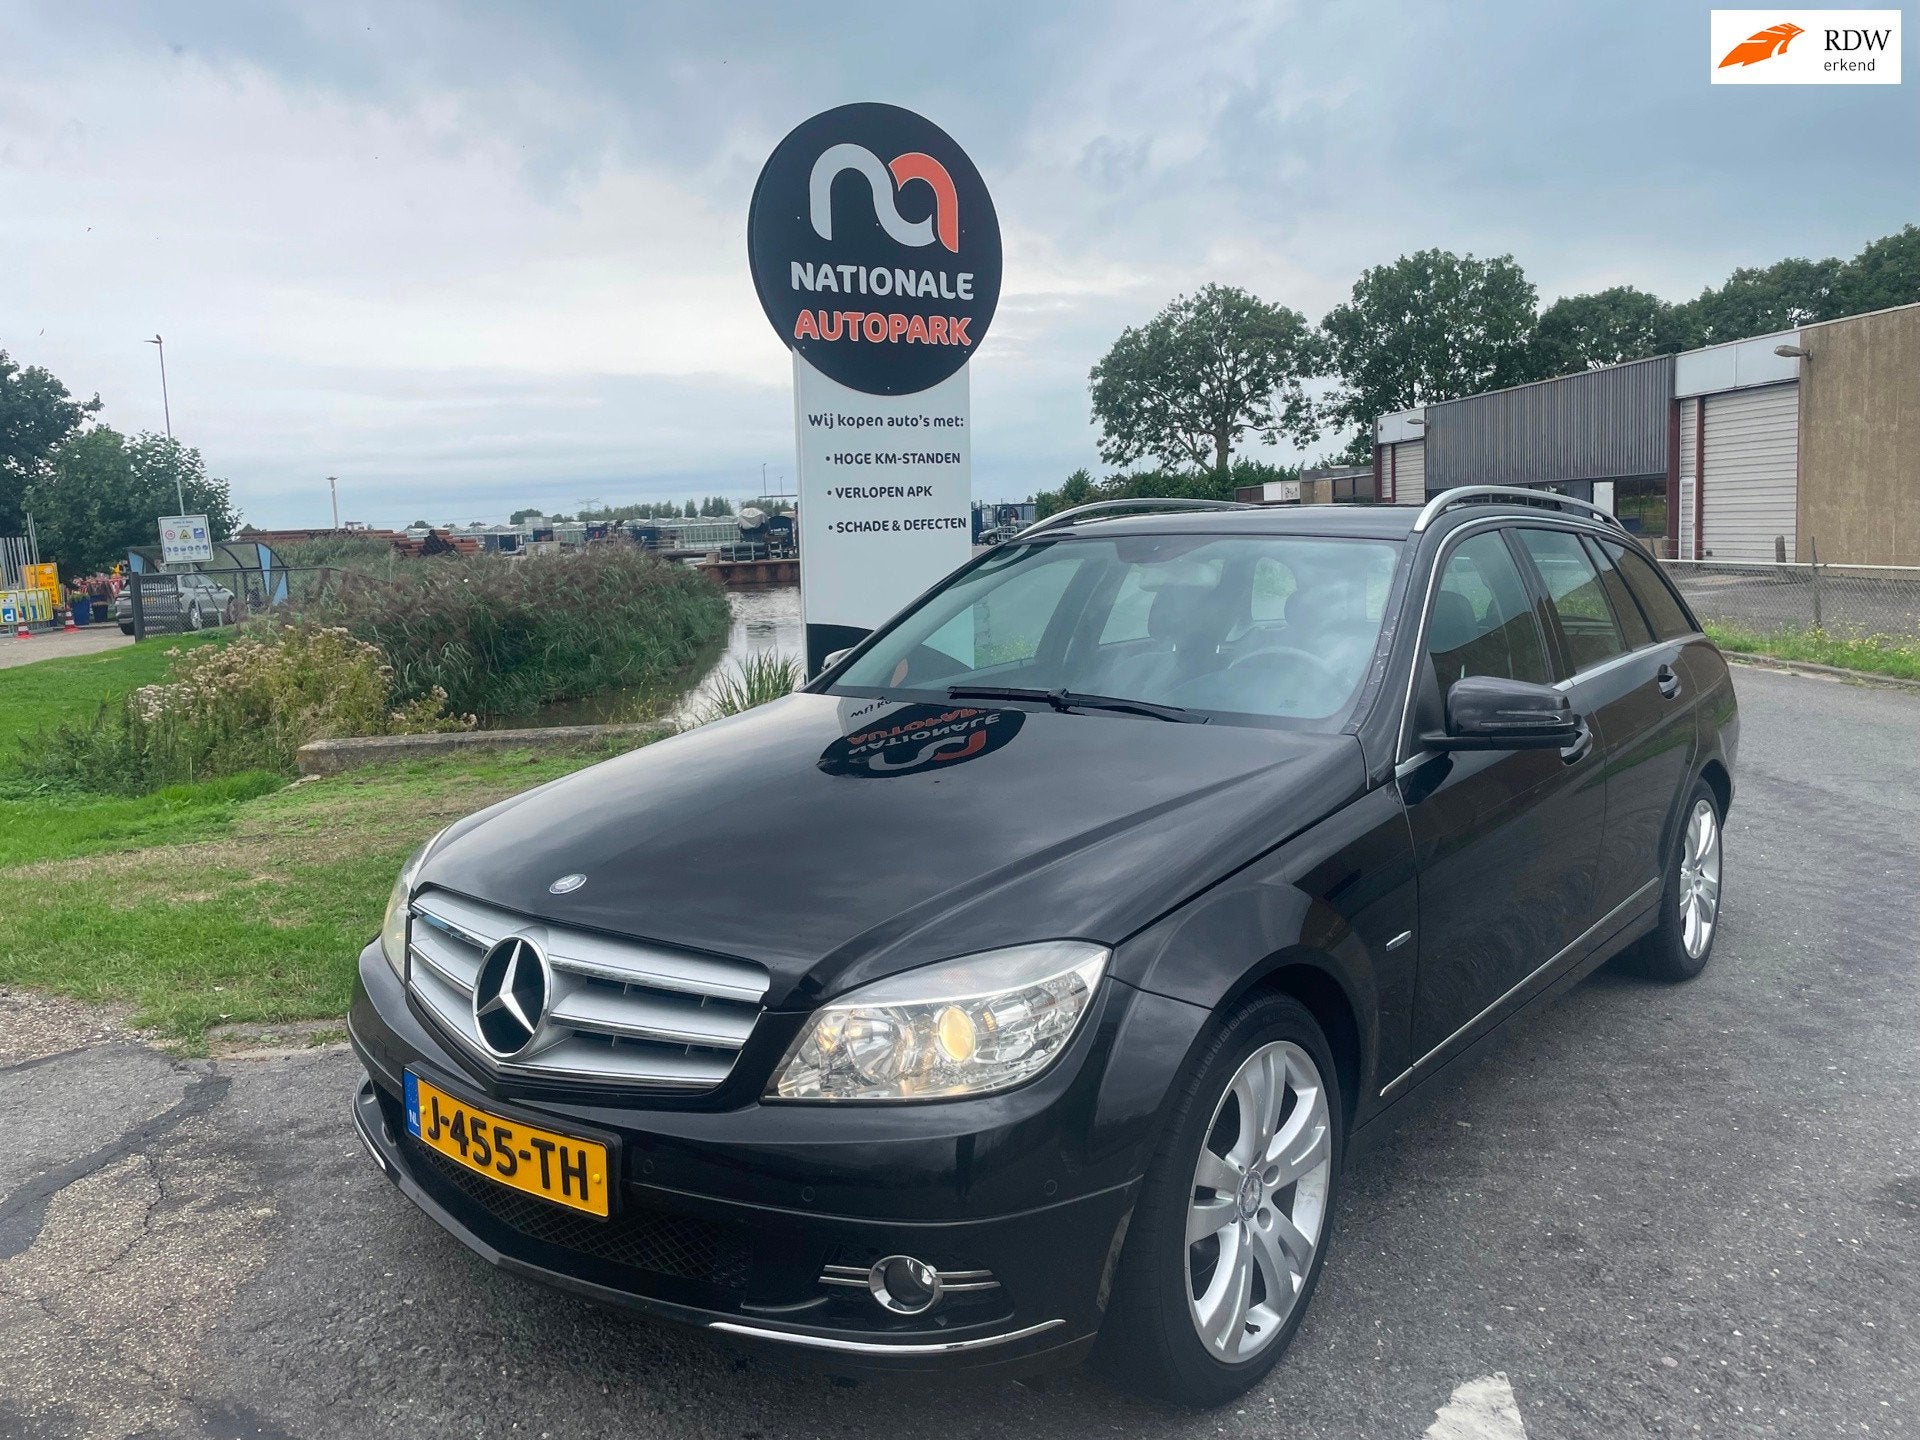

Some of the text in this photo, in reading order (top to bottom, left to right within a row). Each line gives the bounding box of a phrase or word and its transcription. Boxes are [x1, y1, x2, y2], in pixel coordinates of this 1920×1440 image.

[790, 261, 974, 300] NATIONALE
[794, 309, 971, 346] AUTOPARK
[808, 413, 964, 429] Wij kopen auto's met:
[834, 452, 961, 465] HOGE KM-STANDEN
[835, 486, 933, 498] VERLOPEN APK
[836, 517, 967, 533] SCHADE & DEFECTEN
[427, 1096, 589, 1201] J-455-TH
